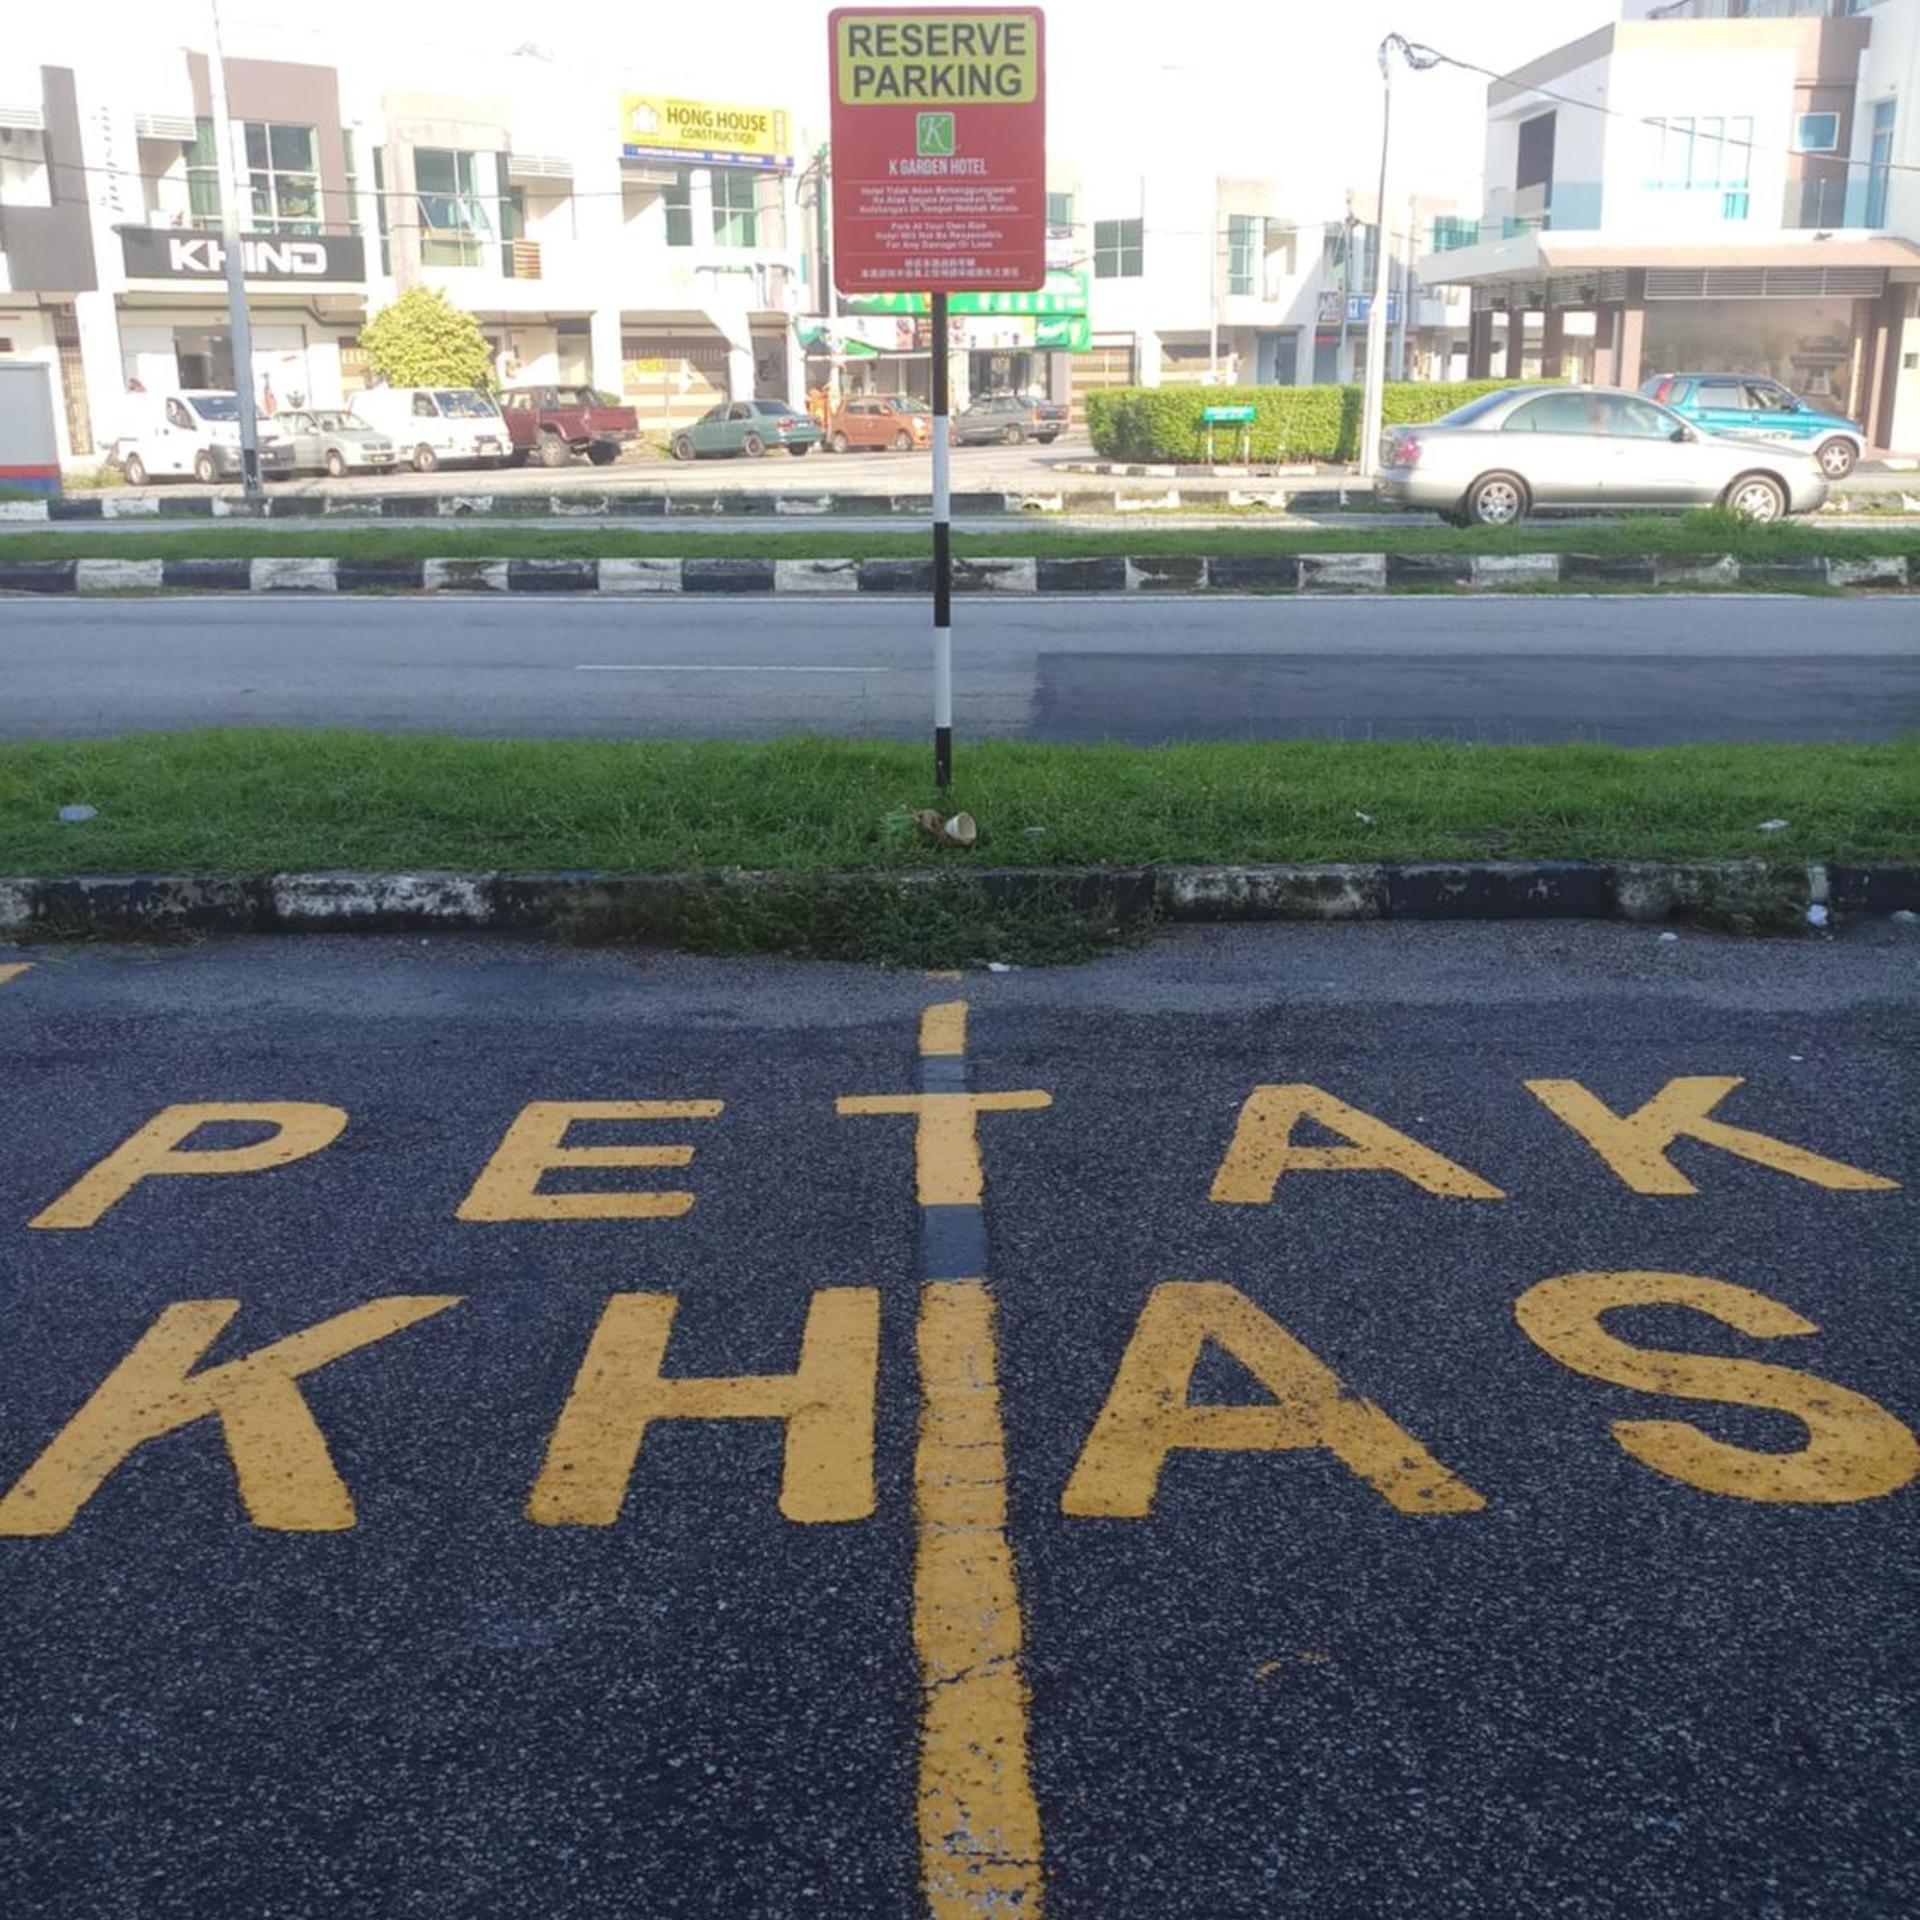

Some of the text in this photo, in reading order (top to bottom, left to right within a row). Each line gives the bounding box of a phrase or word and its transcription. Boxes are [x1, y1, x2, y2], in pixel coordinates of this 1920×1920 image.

[848, 22, 1026, 57] RESERVE
[853, 63, 1022, 98] PARKING
[666, 107, 713, 128] HONG
[716, 111, 767, 132] HOUSE
[680, 128, 756, 145] CONSTRUCTION
[888, 157, 988, 176] K GARDEN HOTEL
[169, 238, 327, 274] KHIND
[27, 1076, 1901, 1230] PETAK
[0, 1270, 1920, 1536] KHAS
